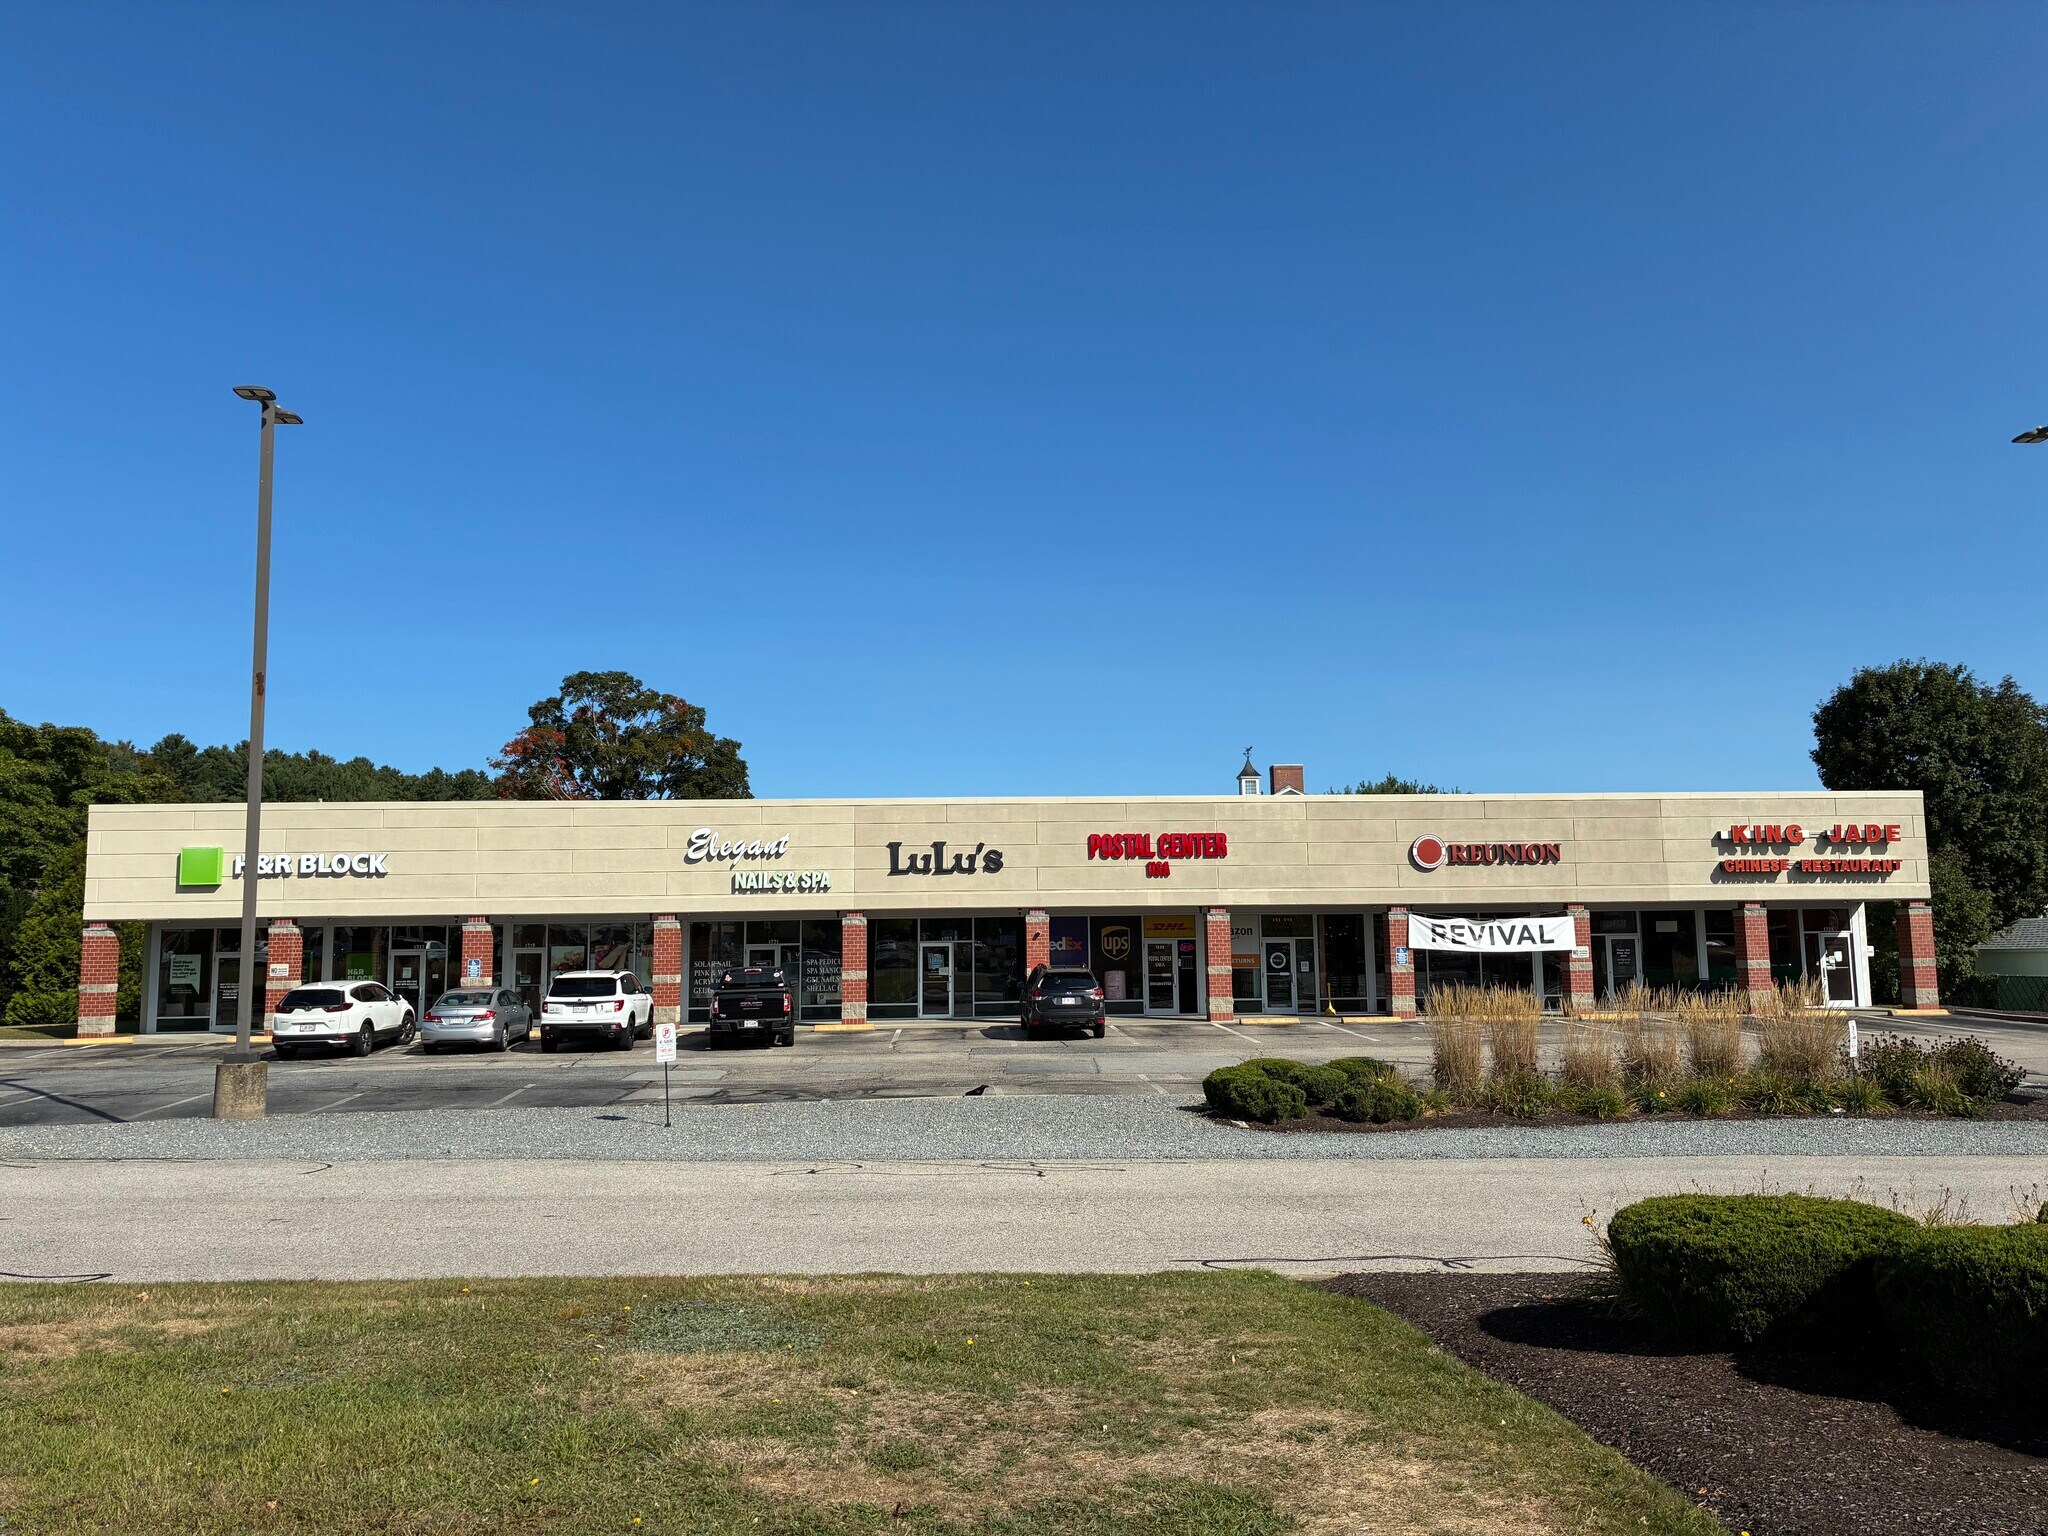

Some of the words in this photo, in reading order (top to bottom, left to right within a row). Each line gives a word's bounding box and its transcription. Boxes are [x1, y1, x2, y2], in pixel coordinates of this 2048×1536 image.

[1731, 824, 1804, 843] KING
[1829, 824, 1902, 843] JADE
[687, 827, 792, 866] Elegant
[1088, 833, 1156, 858] POSTAL
[1158, 832, 1228, 858] CENTER
[1450, 842, 1562, 863] REUNION
[234, 853, 292, 875] H&R
[299, 853, 389, 875] BLOCK
[886, 841, 1004, 876] LuLu's
[1724, 858, 1790, 872] CHINESE
[1801, 858, 1903, 872] RESTAURANT
[1146, 861, 1171, 877] USA
[735, 870, 784, 889] NAILS
[786, 871, 797, 888] &
[800, 870, 832, 889] SPA
[1151, 922, 1186, 931] DHL
[1230, 927, 1253, 936] azon
[1431, 922, 1555, 946] REVIVAL
[1049, 936, 1083, 951] edEx
[1103, 936, 1129, 955] ups
[641, 950, 653, 958] NA
[806, 958, 818, 966] SPA
[806, 967, 818, 975] SPA
[819, 966, 842, 975] MANIC
